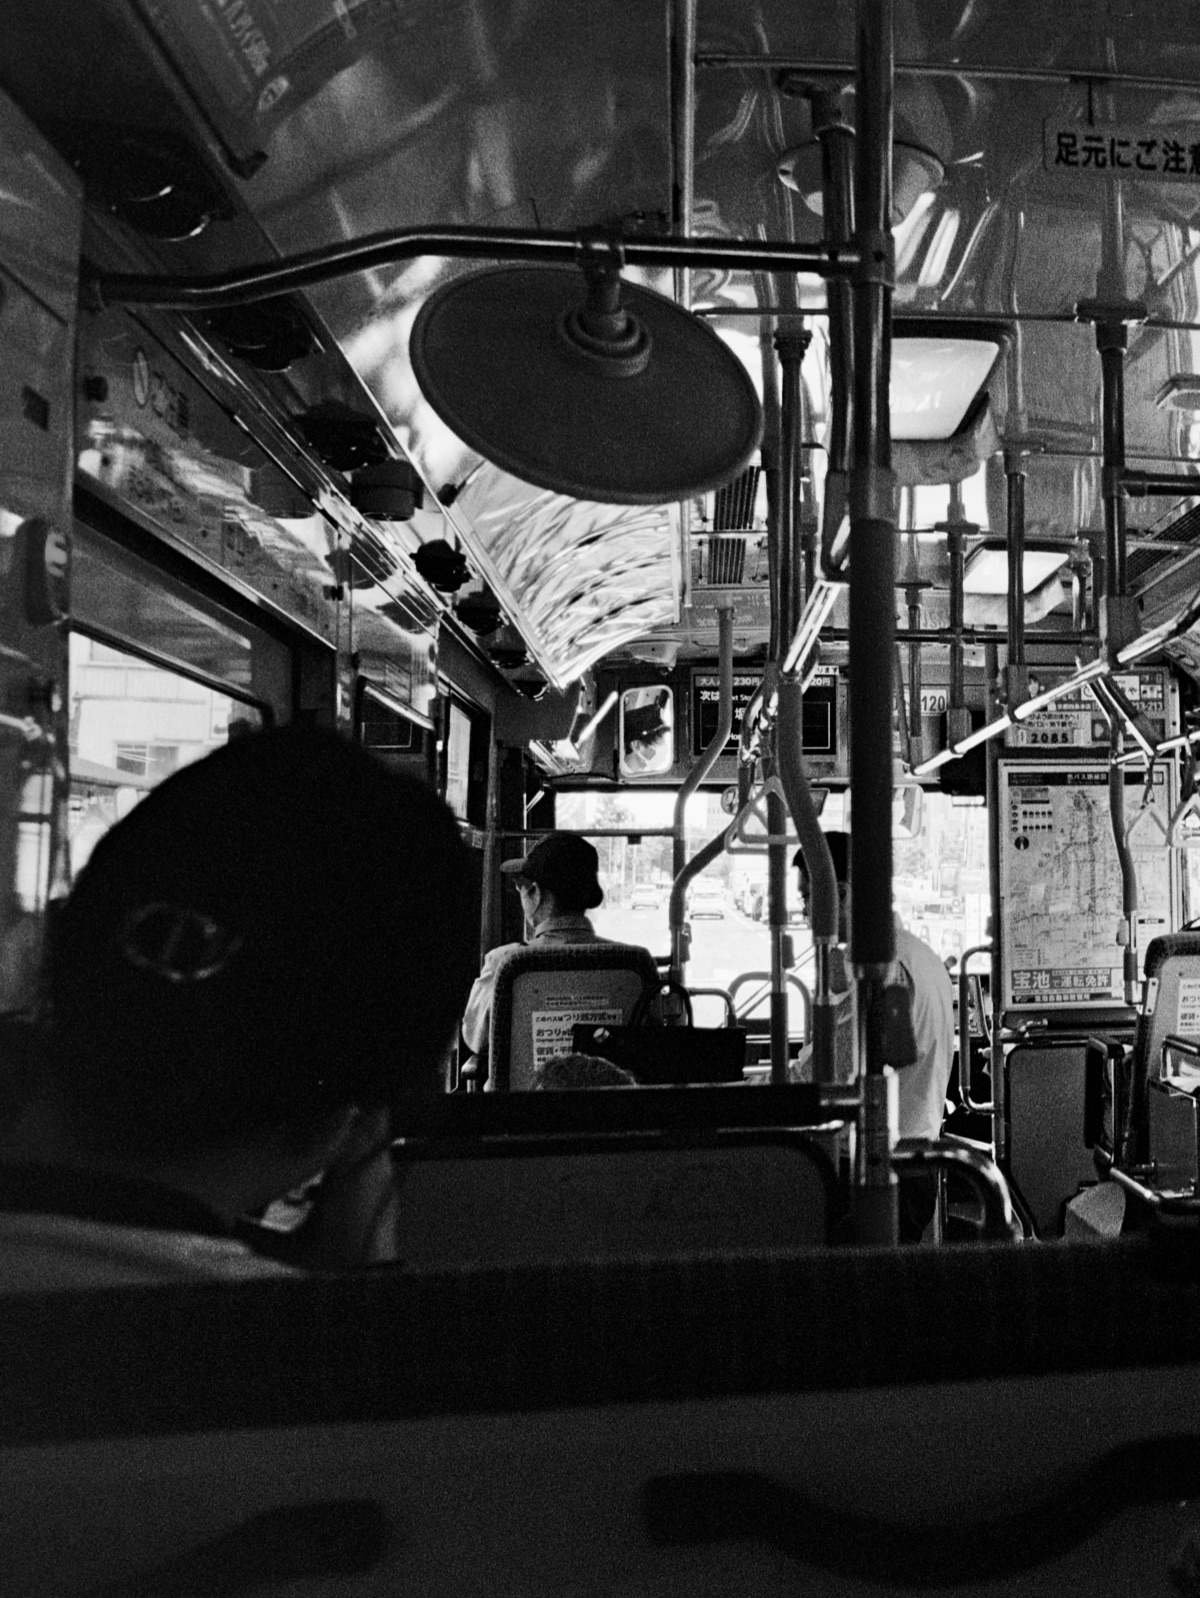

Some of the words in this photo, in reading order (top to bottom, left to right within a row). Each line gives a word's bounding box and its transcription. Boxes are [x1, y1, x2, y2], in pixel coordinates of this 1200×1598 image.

[733, 677, 760, 686] 230円
[810, 677, 831, 686] 20円
[921, 695, 946, 712] 120
[1030, 733, 1069, 744] 2085
